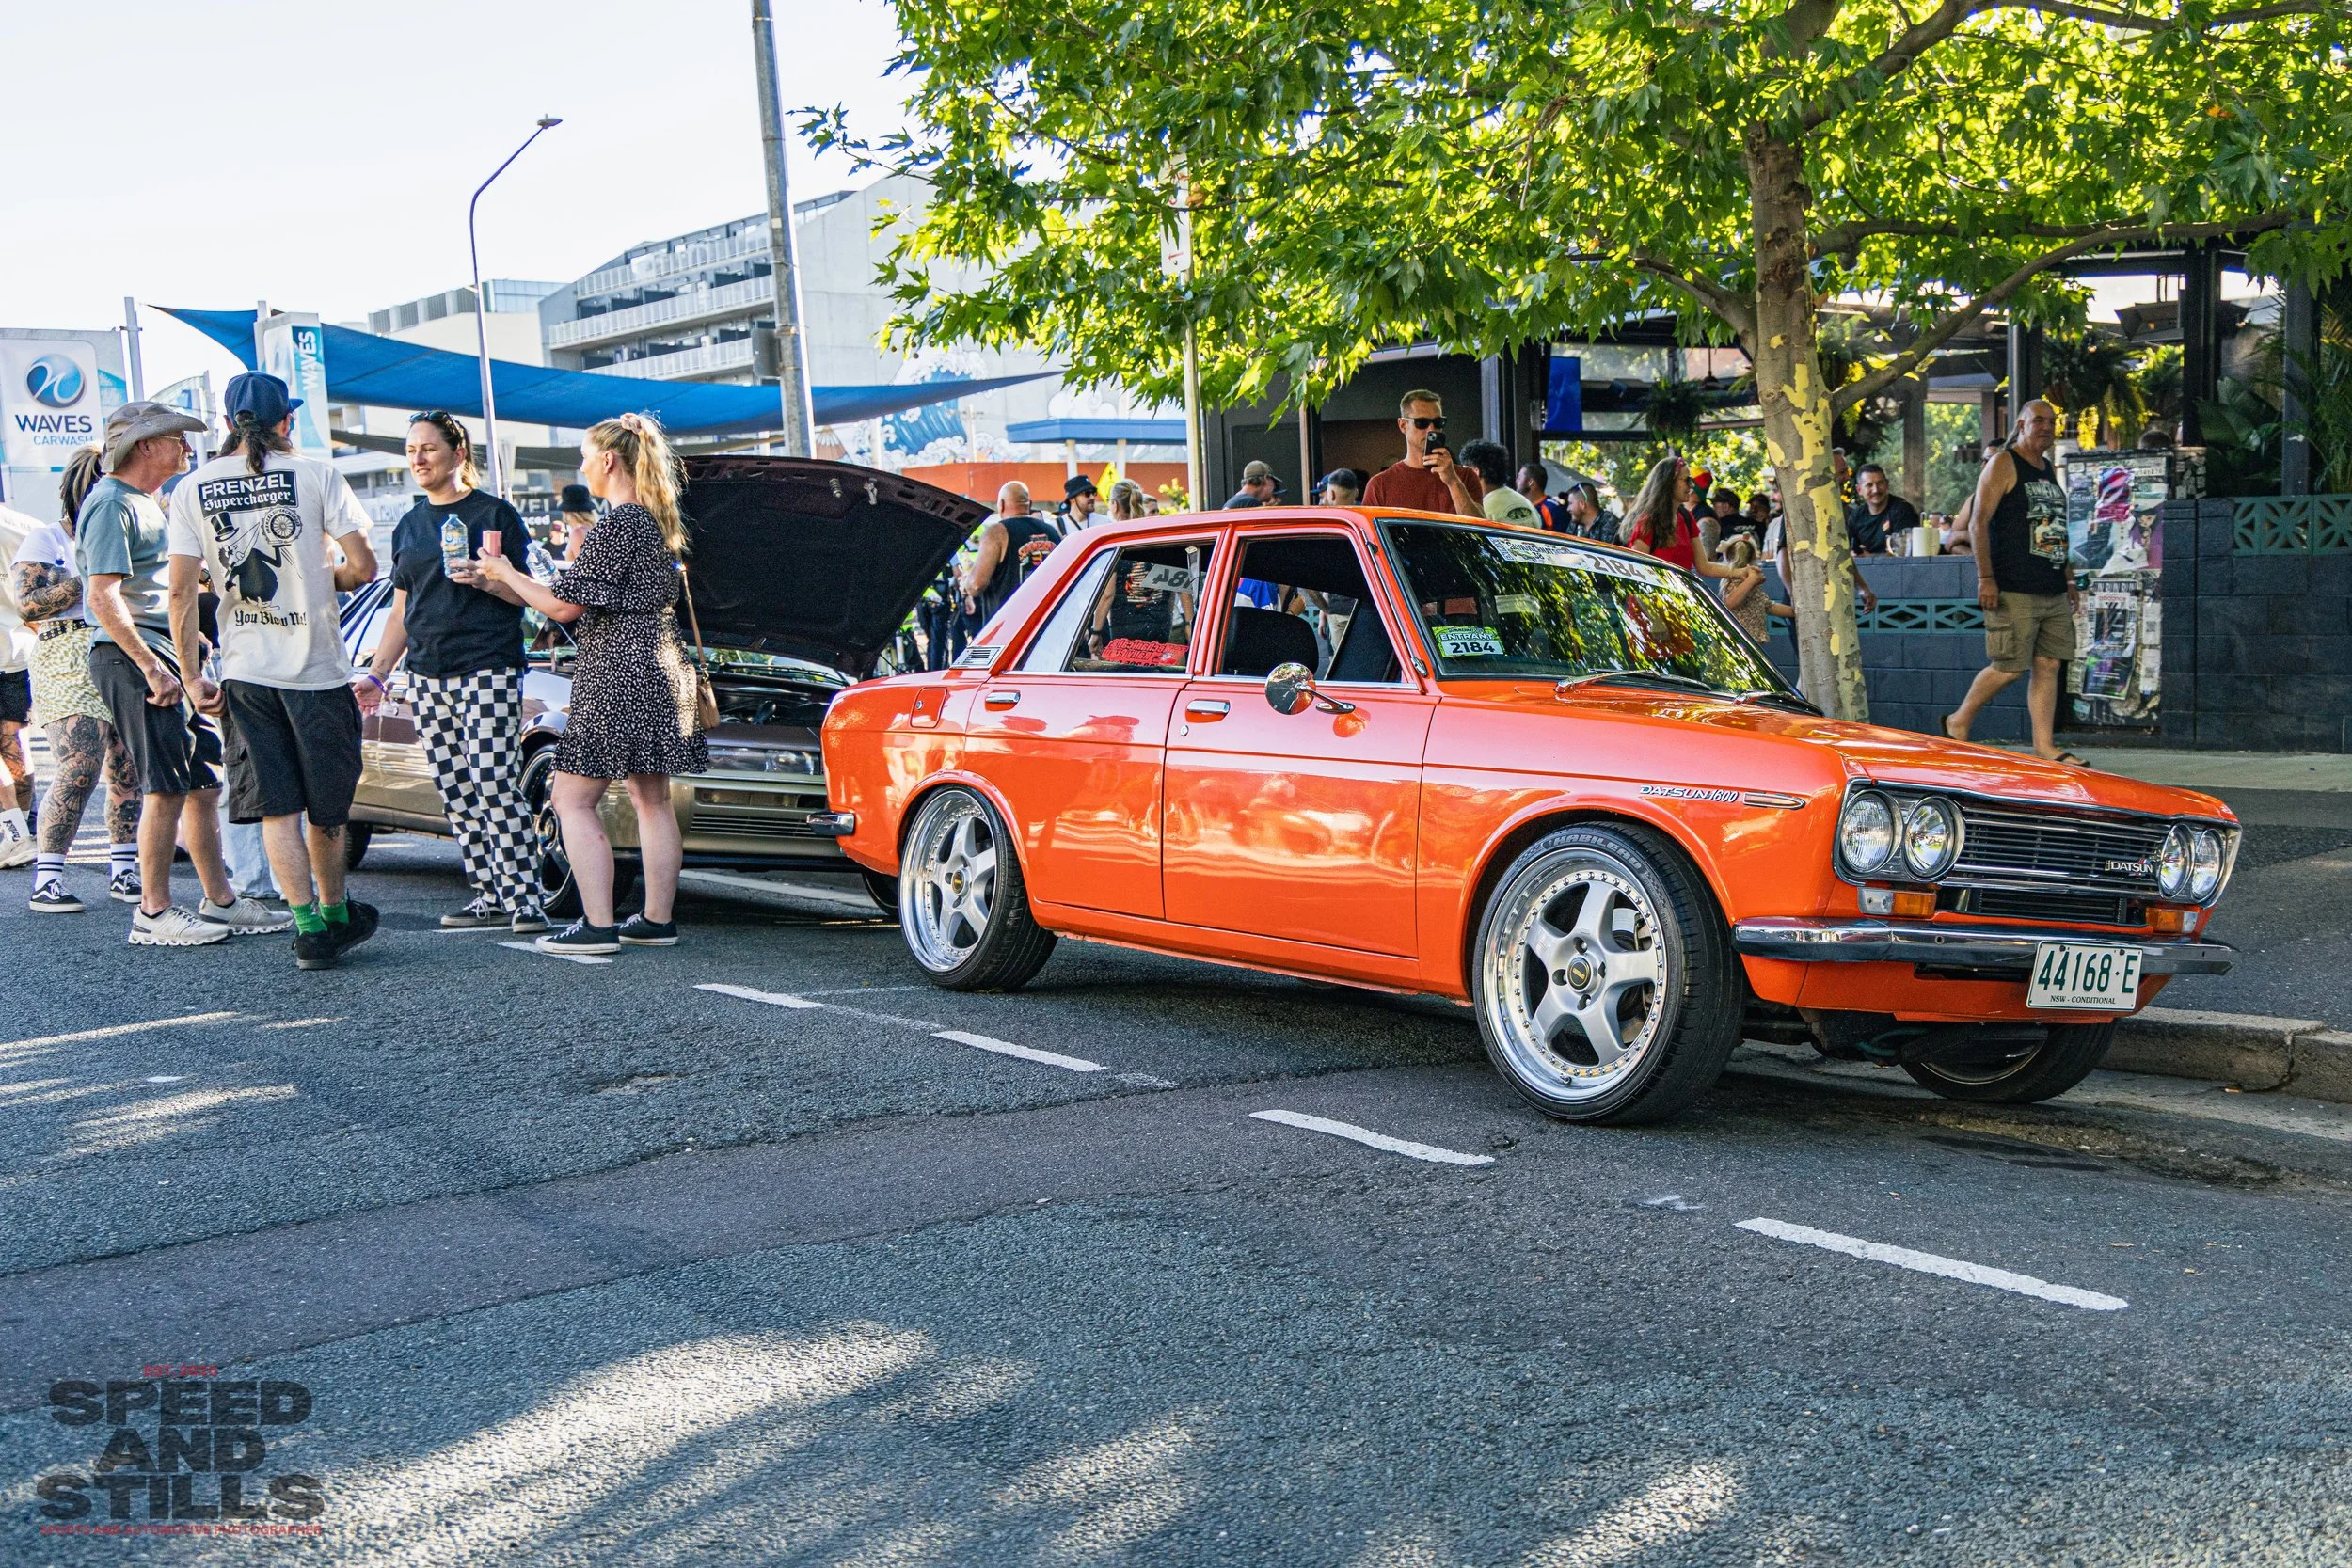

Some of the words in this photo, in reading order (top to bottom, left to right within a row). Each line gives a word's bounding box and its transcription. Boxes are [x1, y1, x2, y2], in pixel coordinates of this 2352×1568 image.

[298, 331, 318, 390] WAVES
[15, 414, 92, 433] WAVES
[201, 473, 292, 500] FRENZEL
[204, 491, 291, 511] Supercharger
[1584, 553, 1646, 580] 2184
[234, 610, 258, 627] You
[1450, 641, 1496, 654] 2184
[1640, 784, 1709, 800] DATSUN
[1708, 788, 1740, 803] 1600
[1553, 833, 1643, 869] HABILEAD
[2110, 861, 2153, 874] DATSUN
[2050, 995, 2067, 1004] NSW
[2071, 996, 2116, 1005] CONDITIONAL
